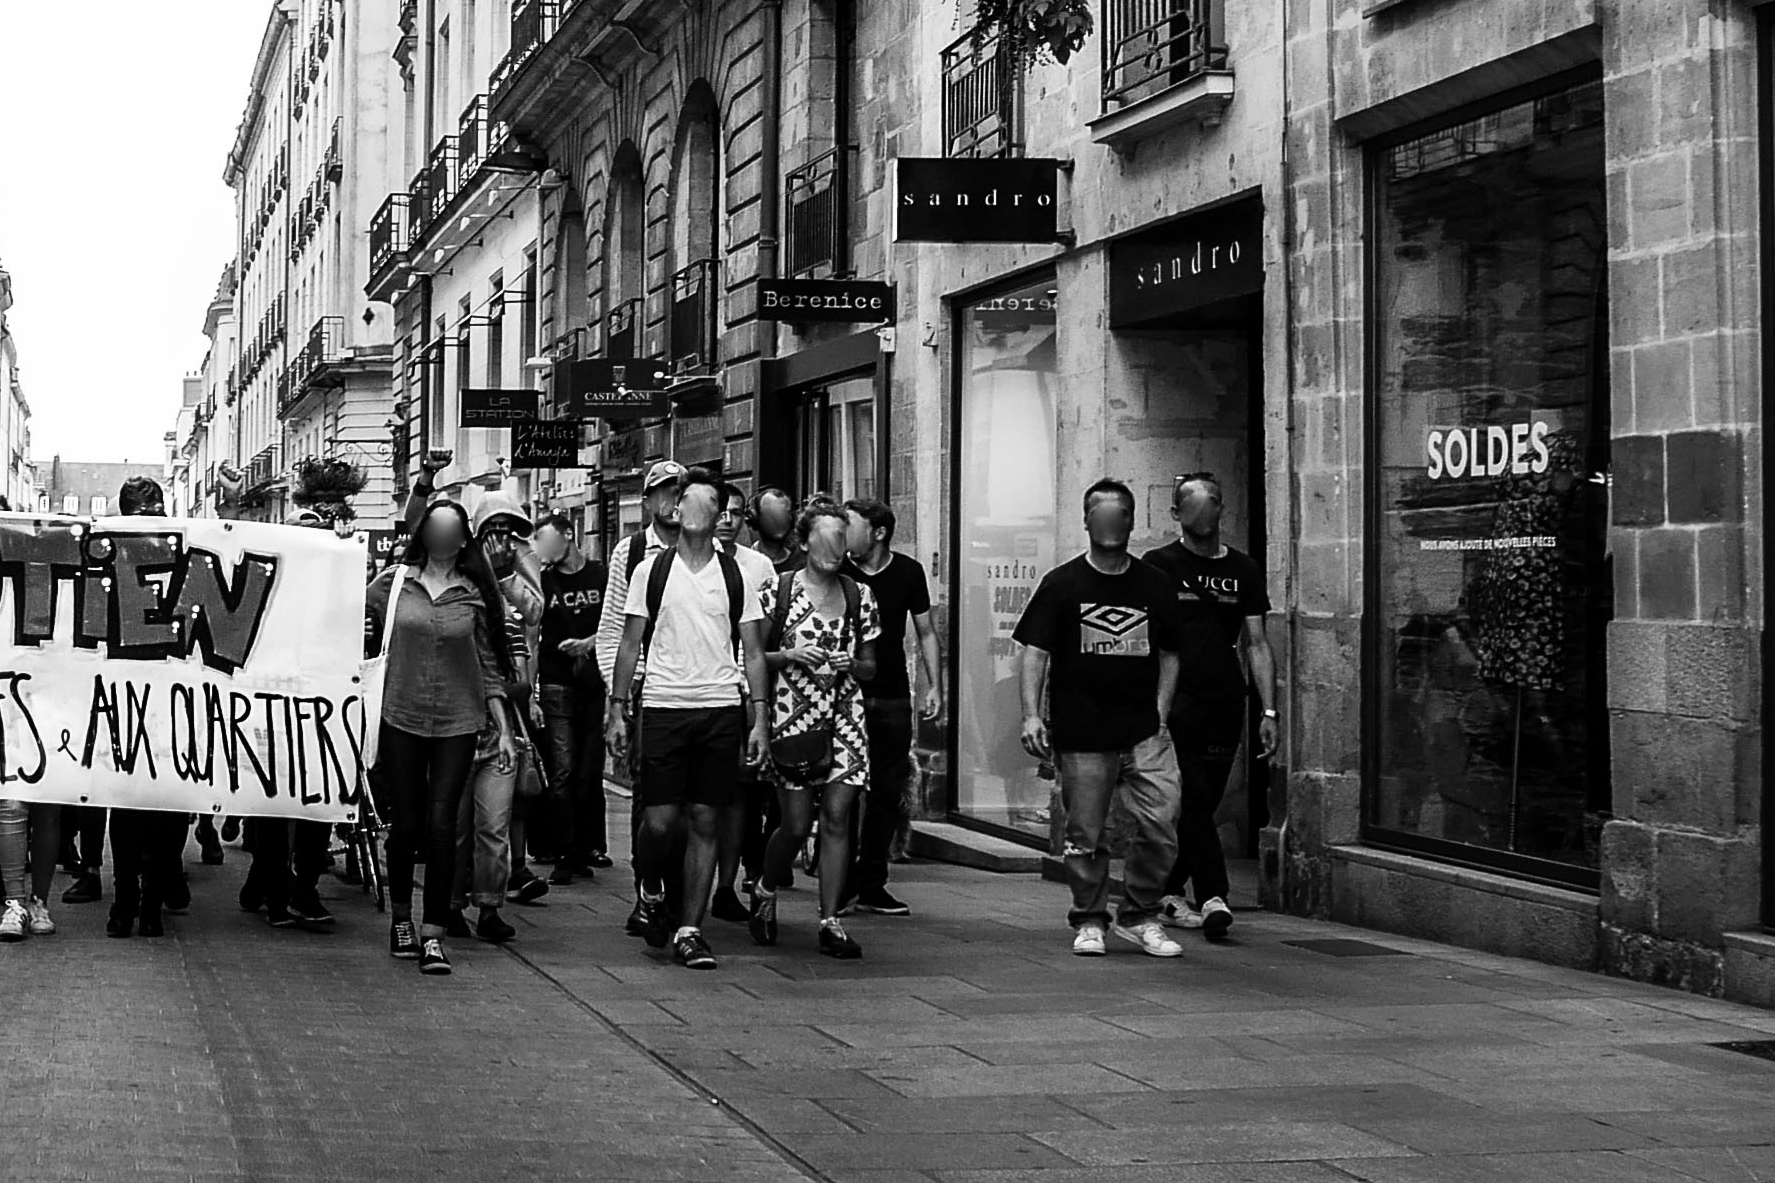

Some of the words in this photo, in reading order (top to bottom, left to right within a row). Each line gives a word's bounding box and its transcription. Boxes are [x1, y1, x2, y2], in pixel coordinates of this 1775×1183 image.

[902, 187, 1052, 208] sandro
[1137, 238, 1242, 290] sandro
[763, 289, 883, 311] Berenice
[489, 397, 510, 406] LA
[466, 409, 535, 419] STATION
[1428, 421, 1549, 479] SOLDES
[987, 559, 1036, 579] sandro
[81, 674, 157, 780] AUX
[170, 682, 362, 805] QUARTIERS
